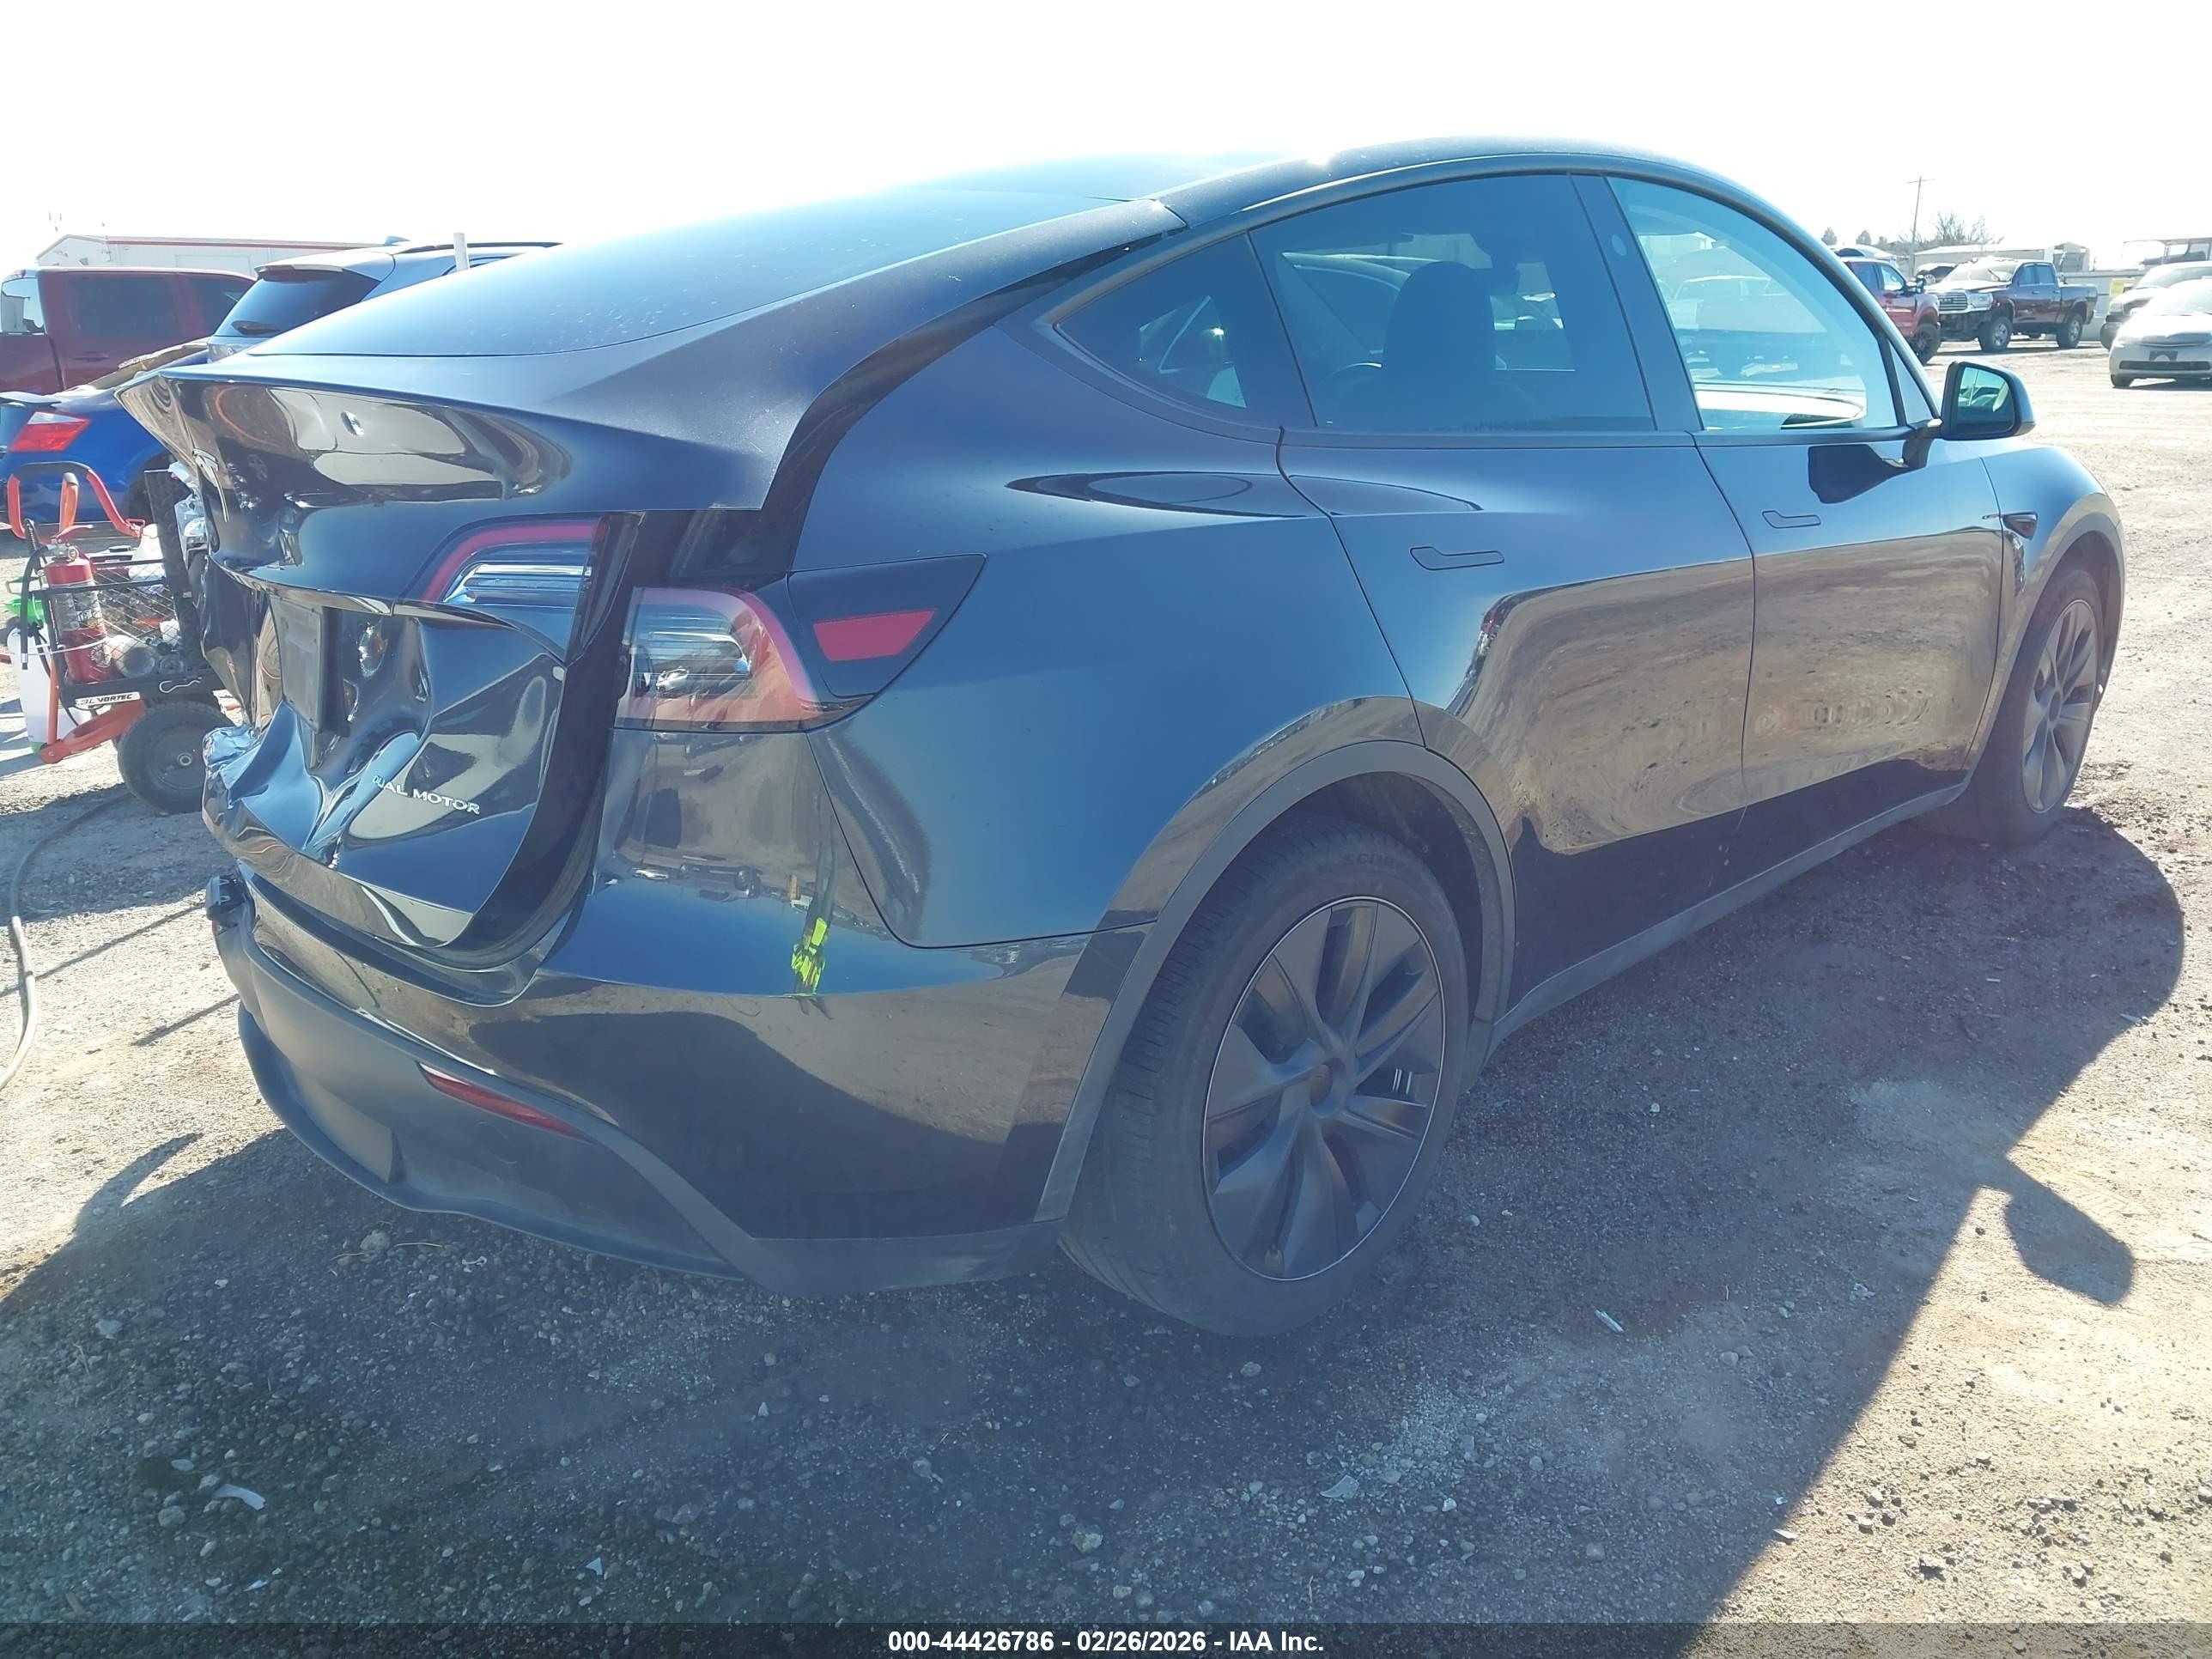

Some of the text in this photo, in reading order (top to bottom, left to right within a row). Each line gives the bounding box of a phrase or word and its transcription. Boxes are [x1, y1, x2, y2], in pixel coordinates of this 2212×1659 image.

[97, 693, 133, 702] VORTEC
[372, 775, 480, 815] DUAL MOTOR
